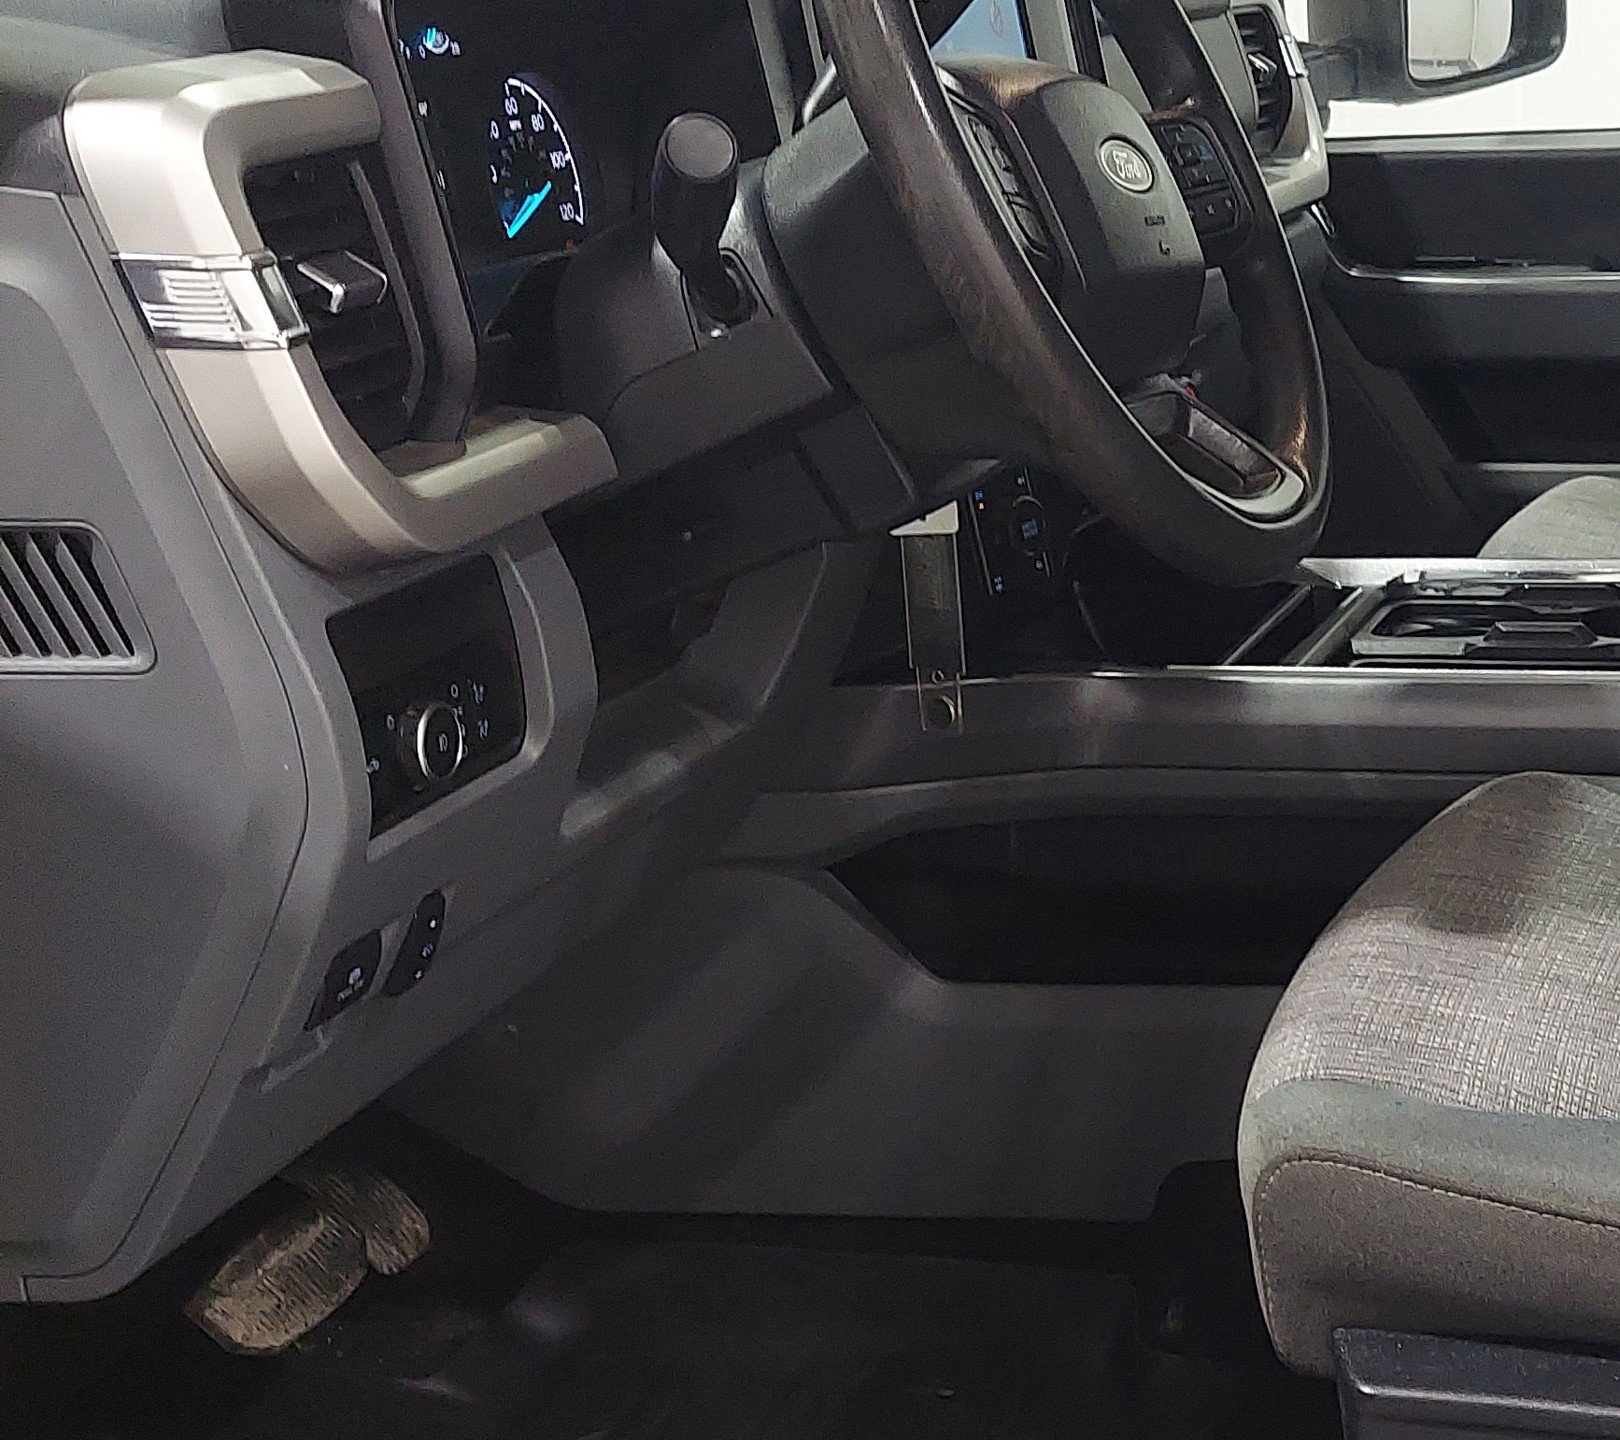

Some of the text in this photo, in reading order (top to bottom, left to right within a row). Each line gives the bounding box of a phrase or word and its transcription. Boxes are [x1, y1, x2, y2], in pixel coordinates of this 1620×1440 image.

[504, 96, 518, 116] 60
[531, 113, 545, 132] 80
[550, 150, 565, 170] 100
[559, 202, 574, 222] 120
